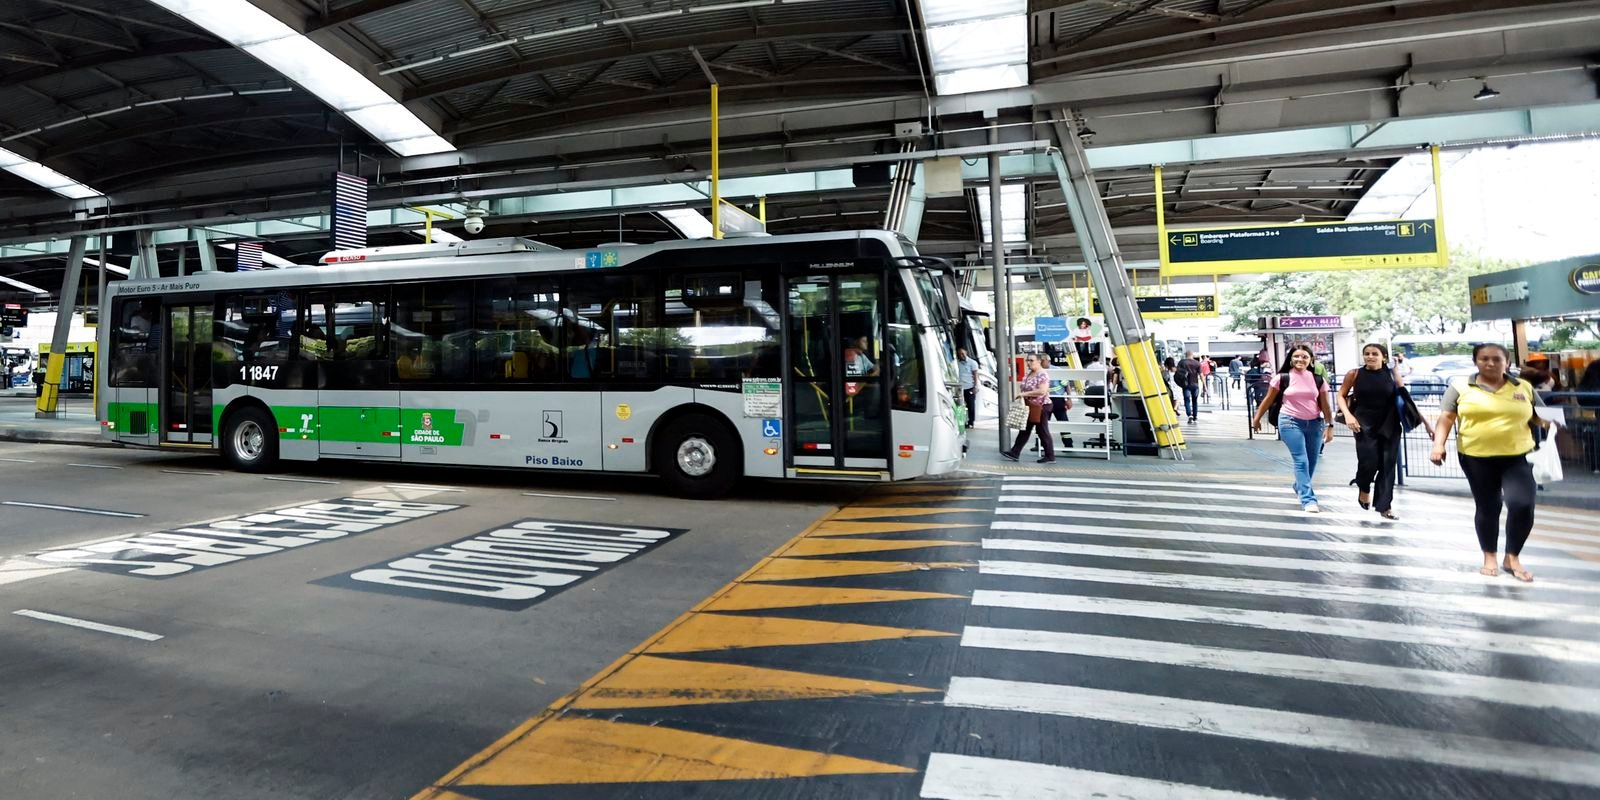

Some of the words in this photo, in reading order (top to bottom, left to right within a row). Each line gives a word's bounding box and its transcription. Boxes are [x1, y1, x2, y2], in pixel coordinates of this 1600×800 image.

[185, 282, 200, 290] Puro
[240, 365, 246, 380] 1
[249, 365, 279, 380] 1847
[411, 434, 424, 442] SÃO
[525, 455, 549, 465] Piso
[552, 456, 583, 466] Baixo
[350, 520, 671, 600] CUIDADO
